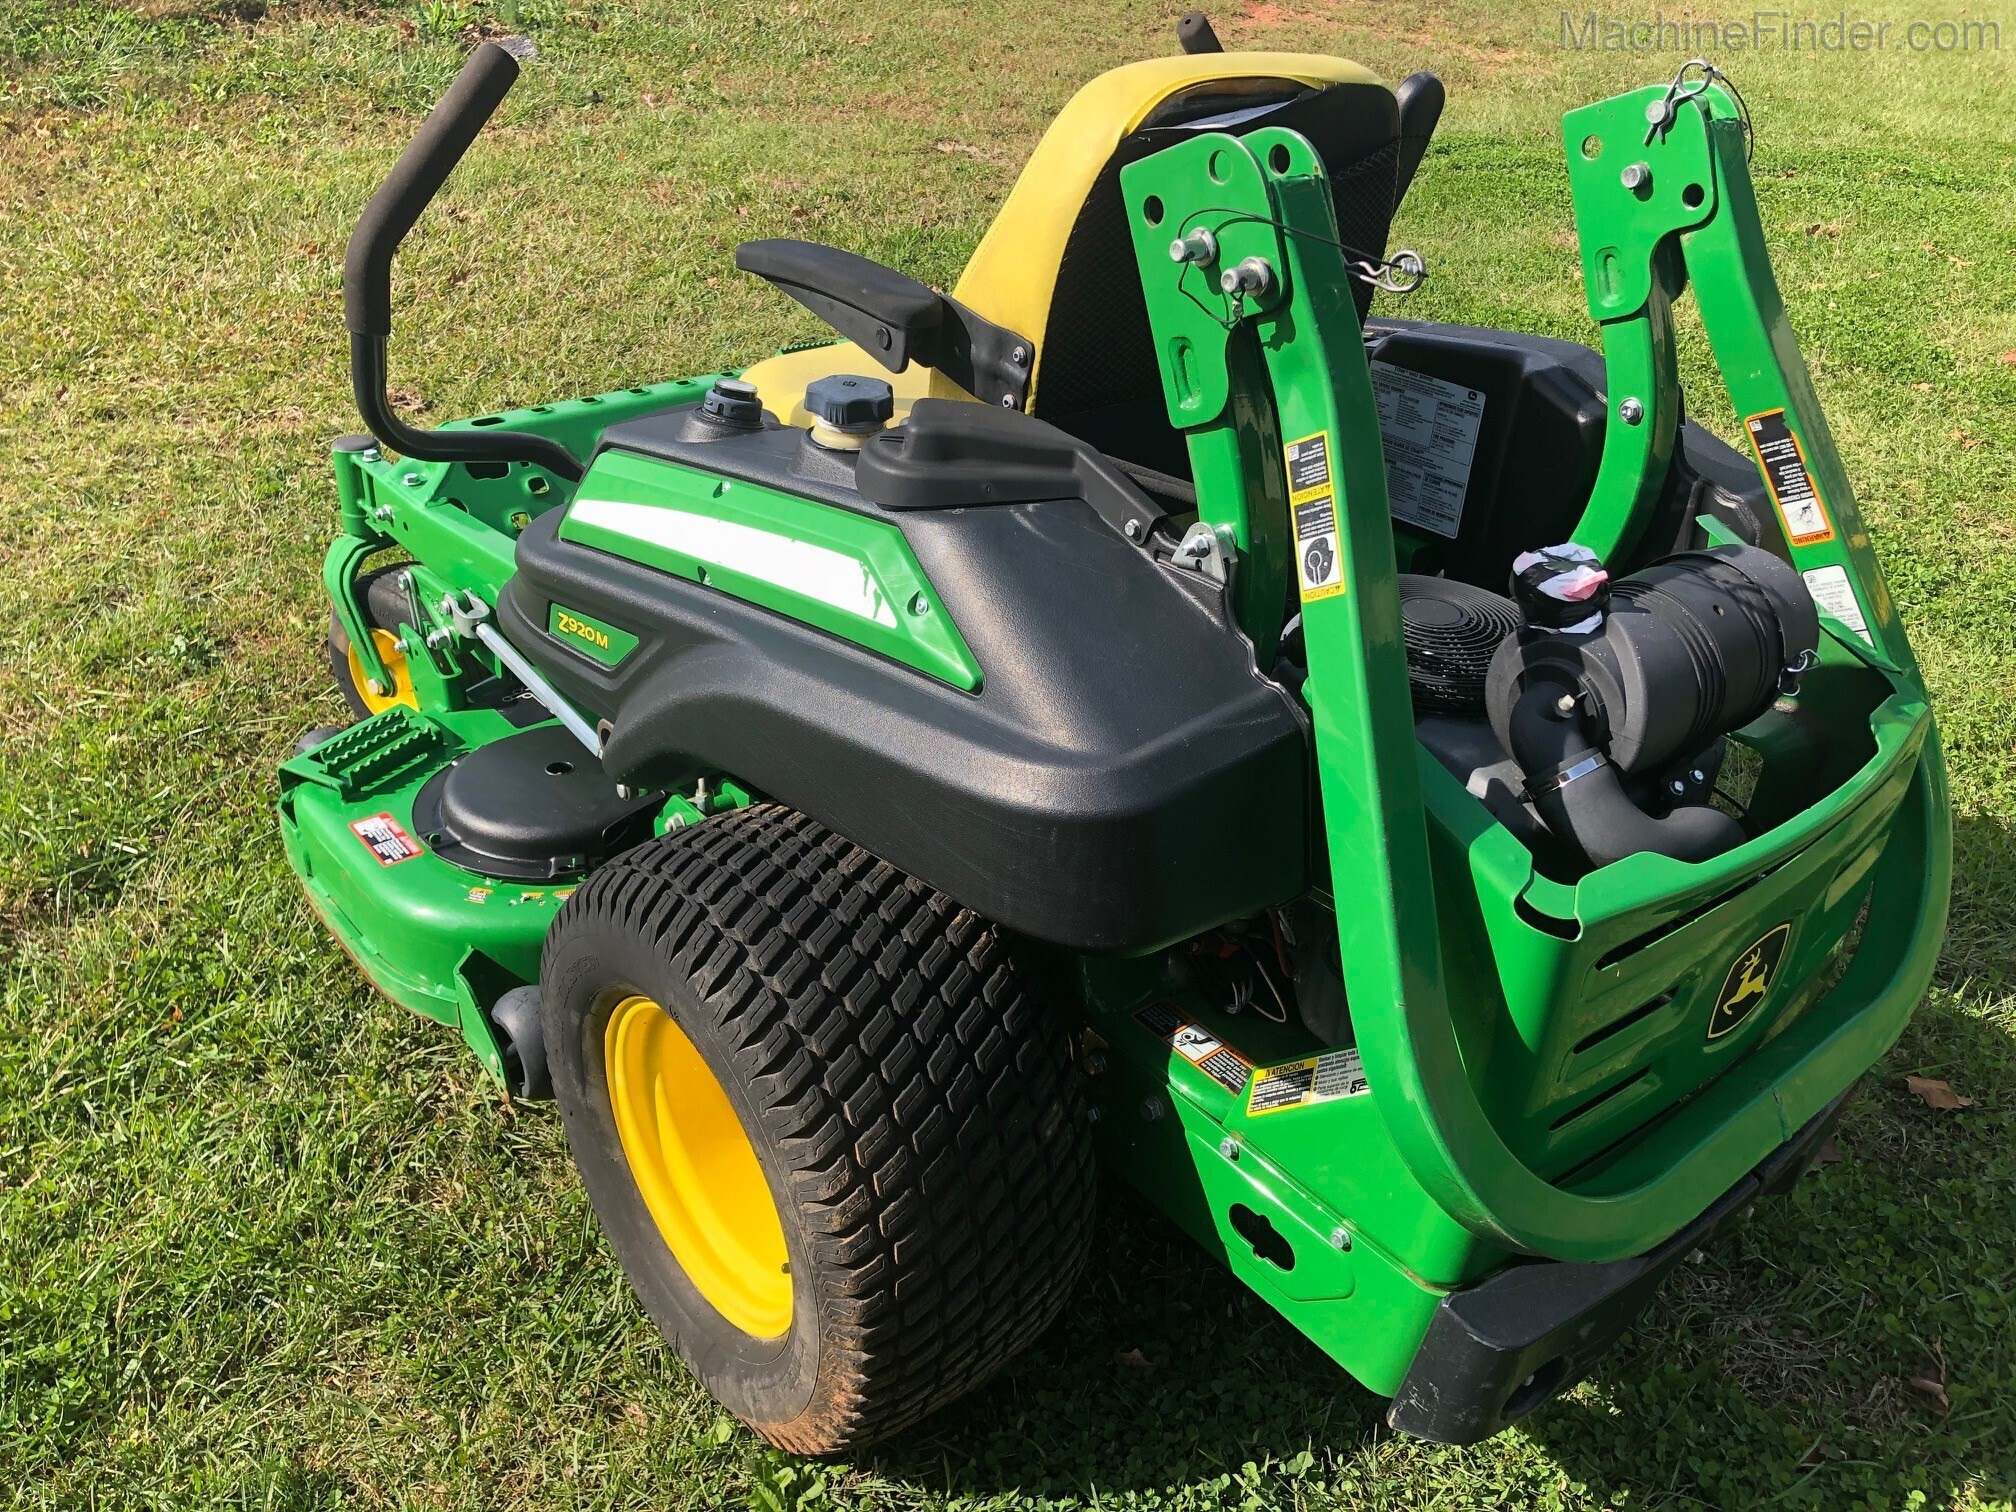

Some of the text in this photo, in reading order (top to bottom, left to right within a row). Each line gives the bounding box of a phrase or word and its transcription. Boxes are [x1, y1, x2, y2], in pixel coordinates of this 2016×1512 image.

[1292, 487, 1324, 502] ATENCIÓN
[1791, 532, 1825, 544] WARNING
[1304, 586, 1335, 599] CAUTION
